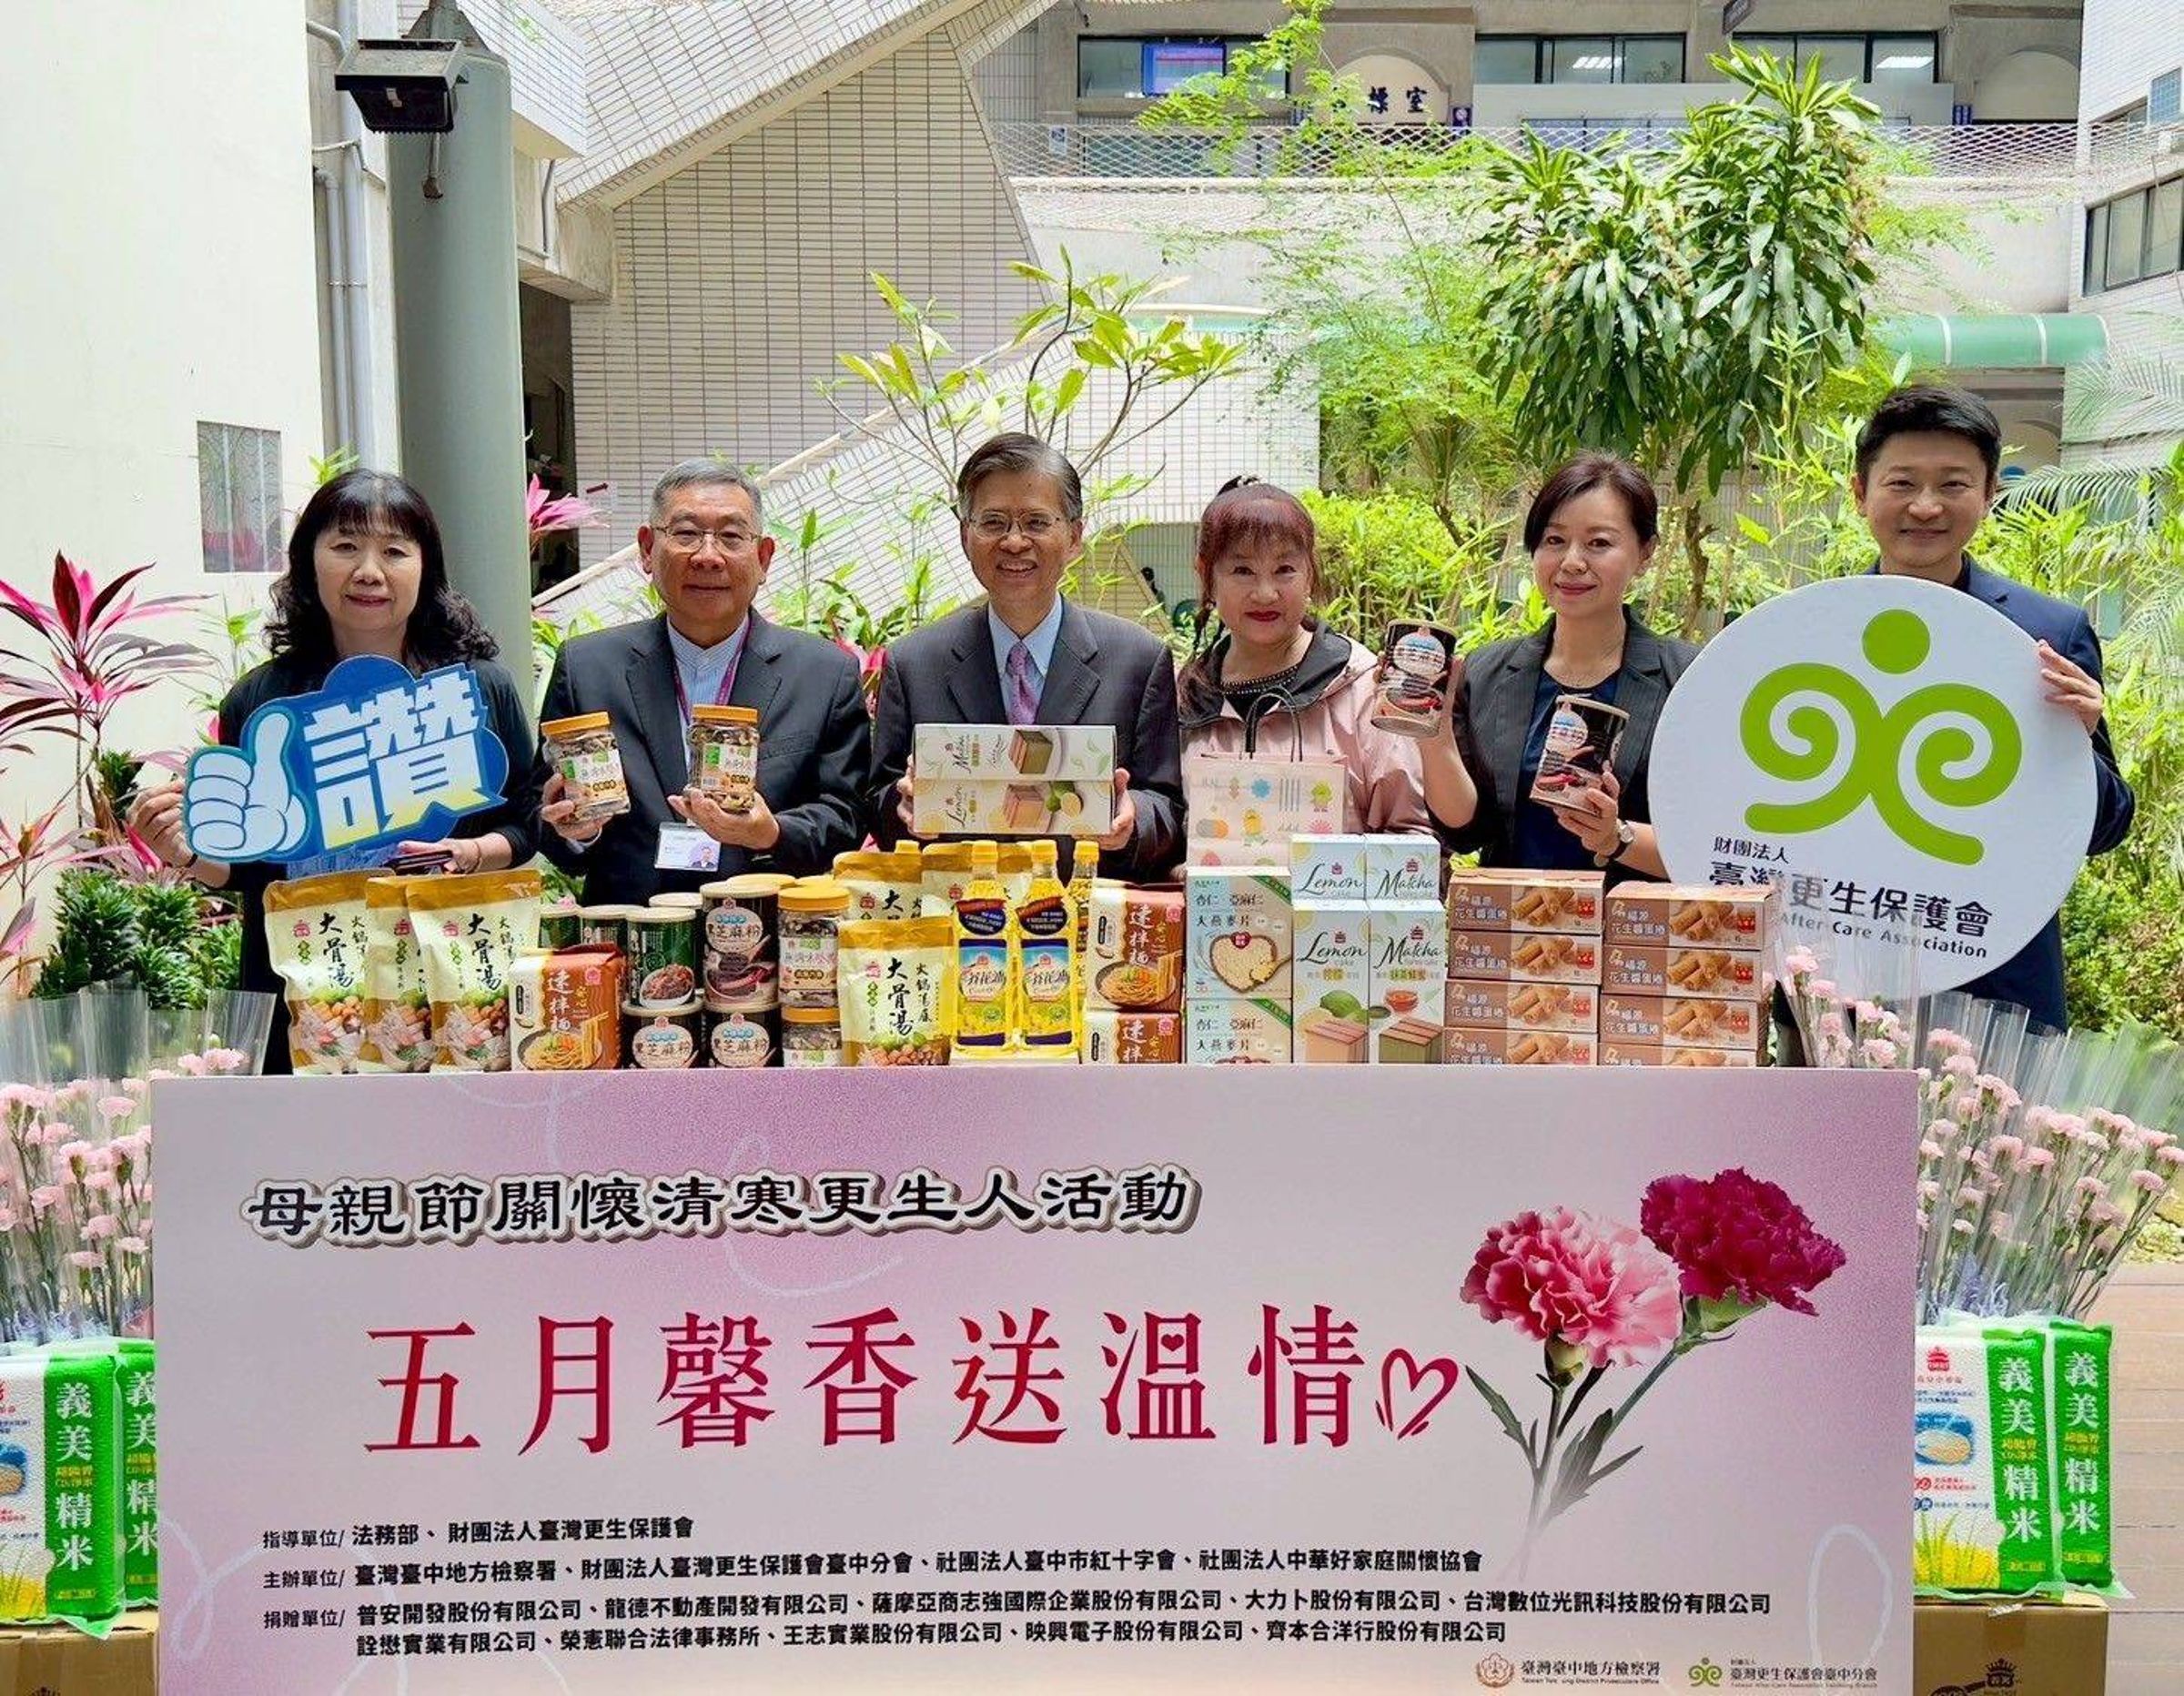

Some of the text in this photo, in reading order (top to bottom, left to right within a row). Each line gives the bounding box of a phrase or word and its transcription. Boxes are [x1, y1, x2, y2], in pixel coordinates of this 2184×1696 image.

[303, 672, 490, 851] 讚
[1298, 863, 1363, 896] Lemon
[1373, 868, 1436, 900] Matcha
[1714, 834, 1791, 865] 財團法人
[1196, 894, 1218, 906] 杏仁
[1832, 920, 1871, 940] Care
[318, 912, 354, 988] 大骨湯
[467, 913, 502, 991] 大骨湯
[1296, 931, 1367, 964] Lemon
[1373, 935, 1441, 969] Matcha
[886, 957, 914, 1036] 大骨湯
[246, 1168, 1190, 1238] 母親節關懷清寒更生人活動
[126, 1371, 156, 1449] 義美
[364, 1305, 1366, 1455] 五月馨香送溫情
[1997, 1356, 2036, 1435] 義美
[2064, 1351, 2099, 1429] 義美
[56, 1382, 93, 1461] 義美
[56, 1492, 94, 1572] 精米
[126, 1479, 157, 1556] 精米
[262, 1529, 346, 1550] 指導單位/
[448, 1516, 693, 1544] 財團法人臺灣更生保護會
[2002, 1464, 2042, 1544] 精米
[2064, 1458, 2101, 1536] 精米
[263, 1569, 346, 1589] 主辦單位/
[263, 1610, 346, 1630] 捐贈單位/
[1521, 1660, 1660, 1676] 臺灣臺中地方檢察署
